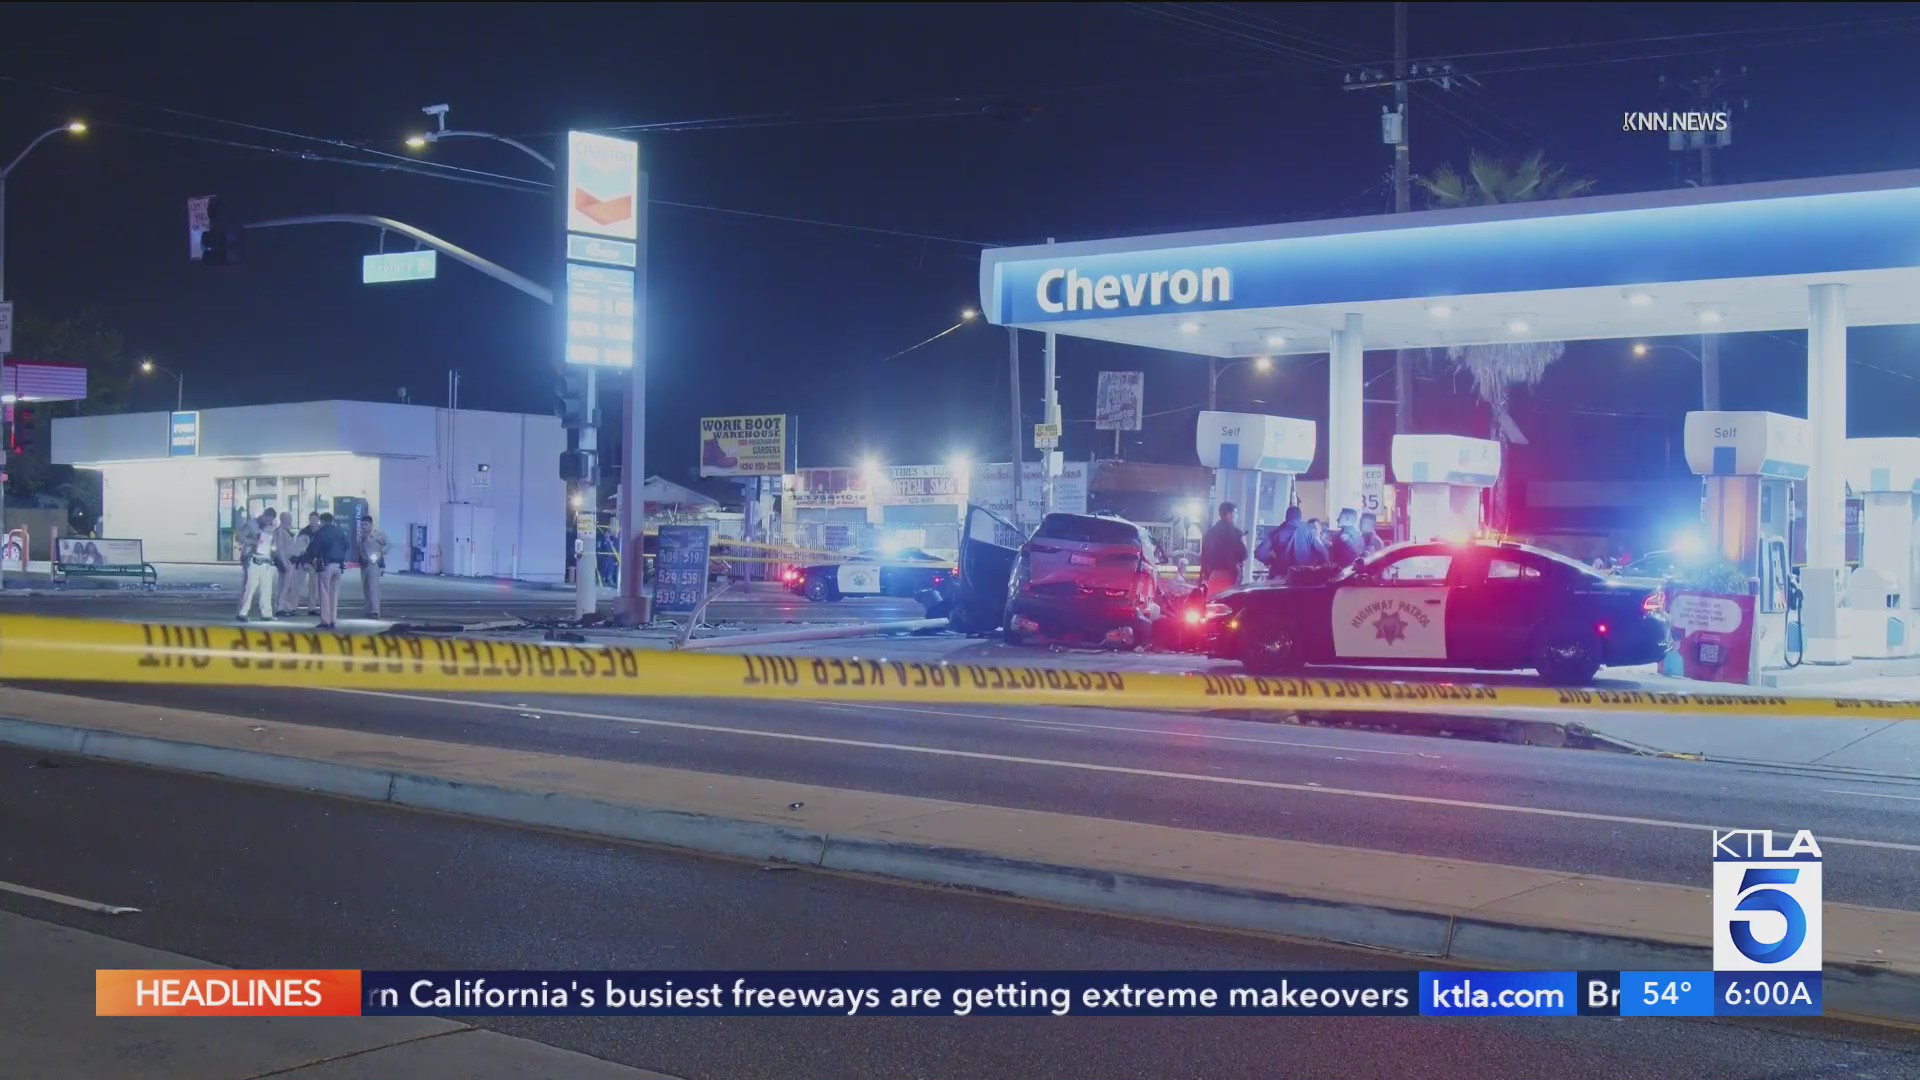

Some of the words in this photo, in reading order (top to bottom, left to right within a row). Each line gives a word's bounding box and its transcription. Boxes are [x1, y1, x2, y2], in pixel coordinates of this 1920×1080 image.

[1036, 266, 1231, 313] Chevron
[702, 419, 741, 432] WORK
[745, 417, 781, 430] BOOT
[713, 429, 780, 440] WAREHOUSE
[1222, 426, 1241, 437] Self
[1714, 427, 1737, 438] Self
[752, 446, 780, 455] GARDENA
[894, 467, 918, 477] TIRES
[893, 478, 930, 495] OFFICIAL
[930, 477, 955, 495] SMOG
[1350, 600, 1394, 629] HIGHWAY
[1398, 600, 1431, 629] PATROL
[138, 623, 211, 668] OUT
[231, 627, 324, 670] KEEP
[333, 632, 424, 674] AREA
[436, 636, 639, 678] RESTRICTED
[742, 653, 799, 685] OUT
[811, 656, 885, 687] KEEP
[891, 660, 962, 688] AREA
[967, 664, 1125, 691] RESTRICTED
[1203, 674, 1247, 696] OUT
